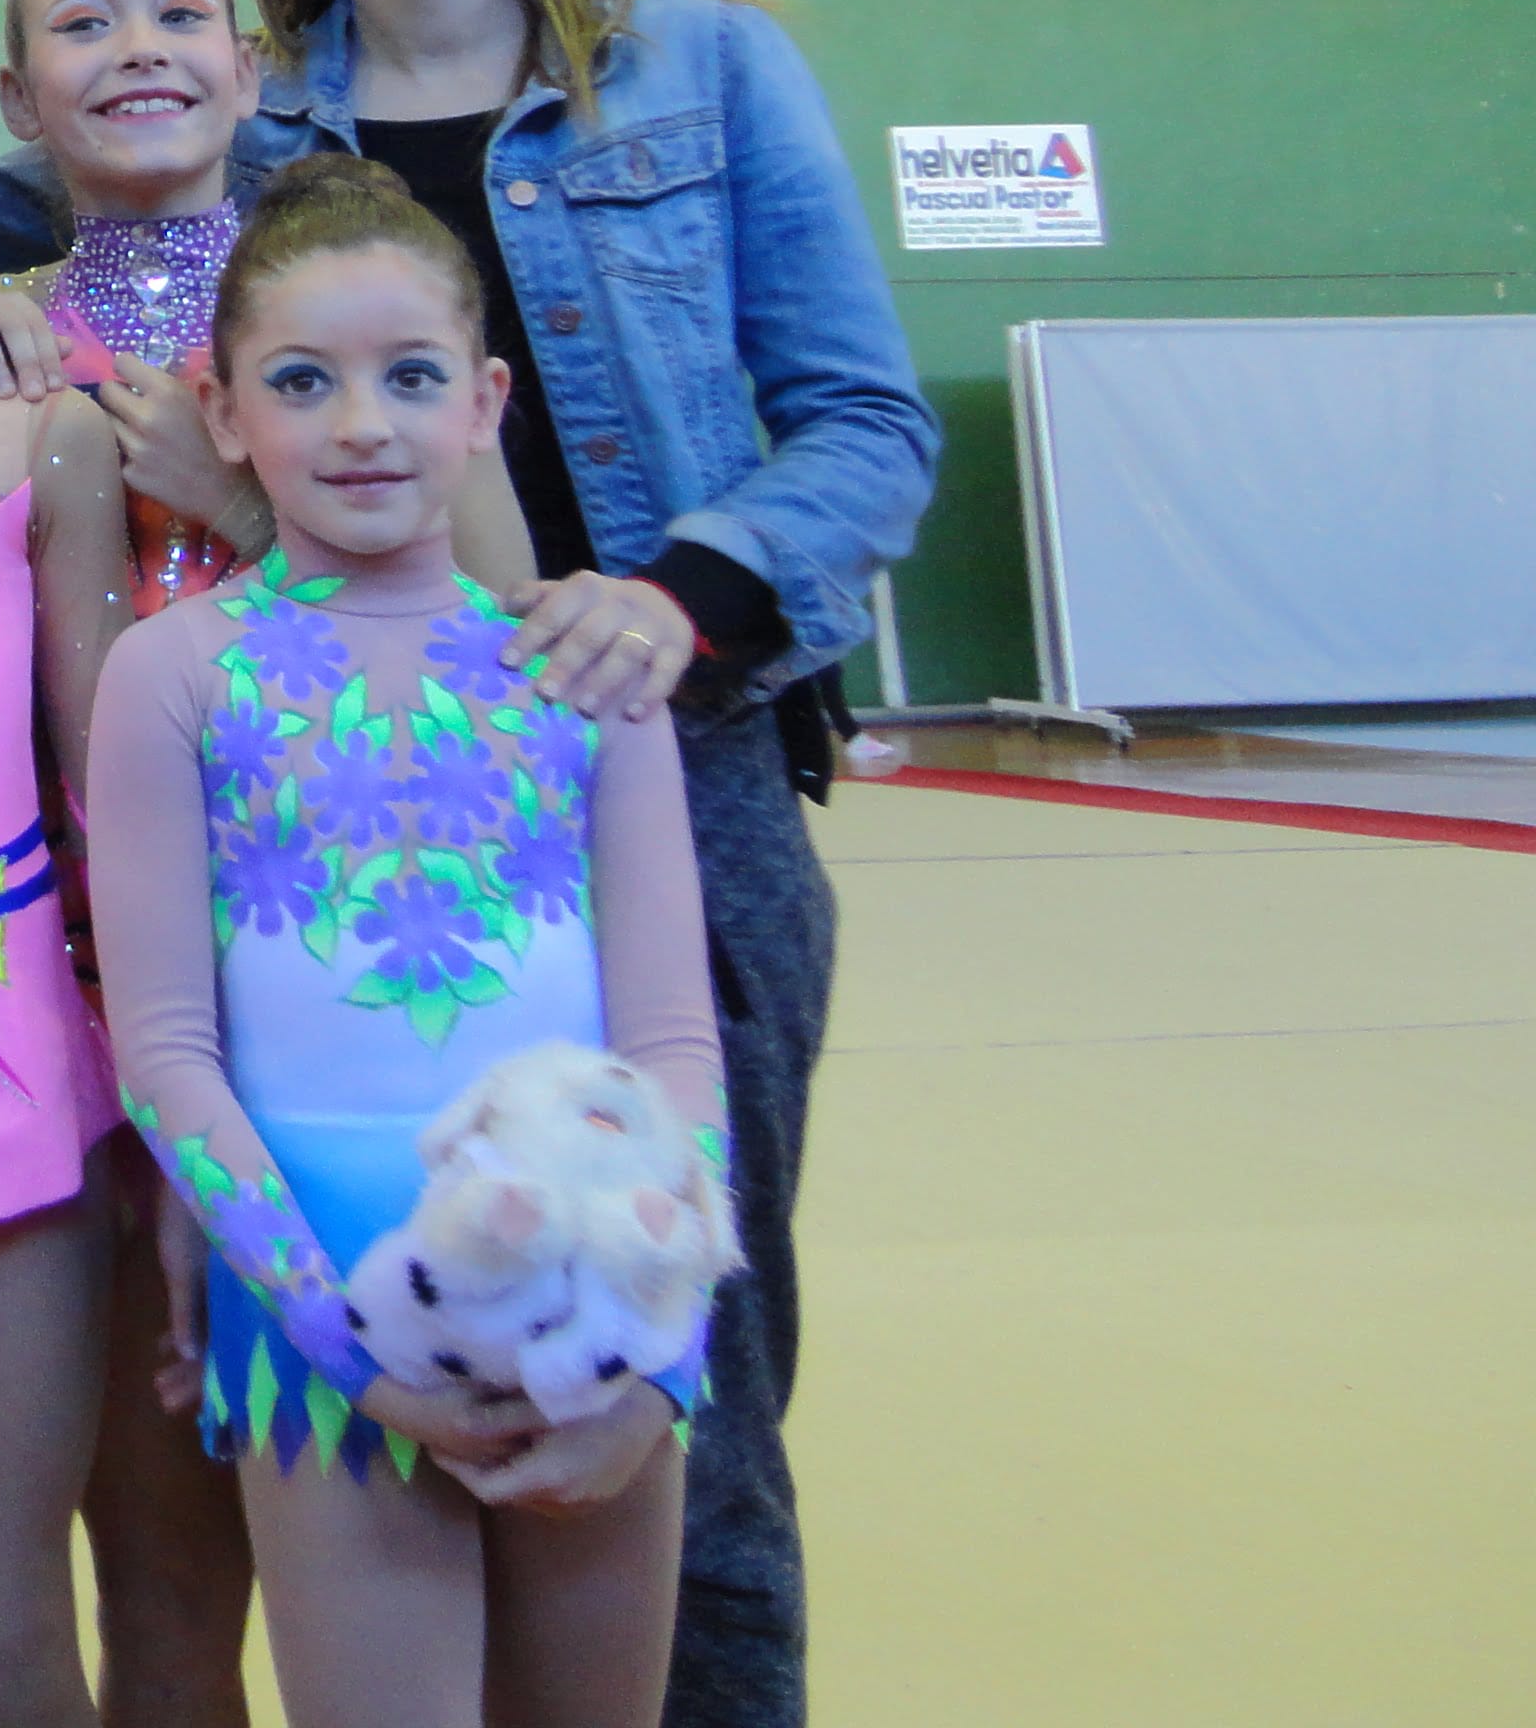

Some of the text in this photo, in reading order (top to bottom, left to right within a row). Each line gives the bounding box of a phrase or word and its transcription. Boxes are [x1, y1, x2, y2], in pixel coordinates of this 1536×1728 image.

[898, 134, 1035, 178] helvetia
[905, 184, 1074, 210] Pascual Pastor
